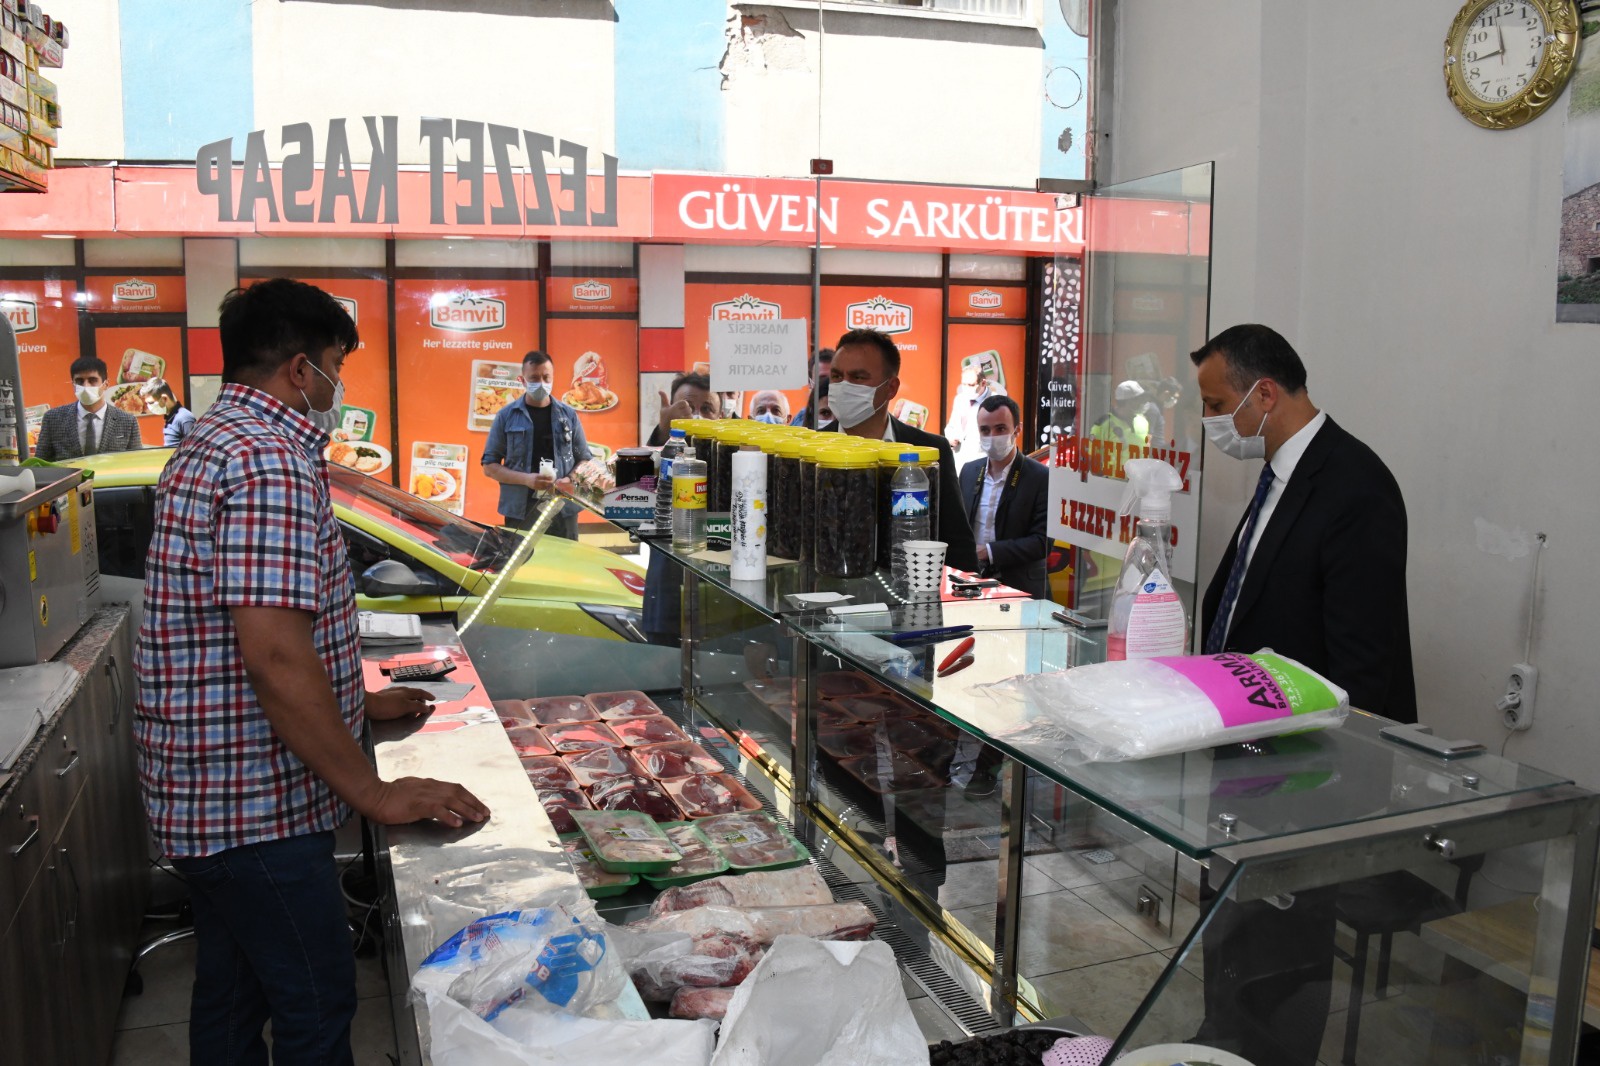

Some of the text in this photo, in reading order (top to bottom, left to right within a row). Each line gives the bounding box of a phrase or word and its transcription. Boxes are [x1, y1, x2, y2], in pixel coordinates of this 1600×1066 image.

[1496, 3, 1514, 18] 12
[1521, 7, 1527, 19] 1
[1481, 16, 1493, 28] 11
[1527, 18, 1537, 31] 2
[1472, 32, 1487, 44] 10
[1531, 36, 1541, 49] 3
[1467, 51, 1477, 63] 9
[1527, 56, 1537, 68] 4
[1470, 67, 1480, 80] 8
[1516, 74, 1526, 86] 5
[1481, 80, 1490, 93] 7
[1497, 85, 1507, 97] 6
[679, 183, 840, 235] GÜVEN
[117, 286, 152, 296] Banvit
[576, 287, 608, 297] Banvit
[972, 296, 999, 305] Banvit
[436, 305, 499, 323] Banvit
[852, 310, 906, 327] Banvit
[423, 338, 512, 351] Her lezzette güven
[621, 493, 649, 502] Persan
[1060, 498, 1116, 541] LEZZET
